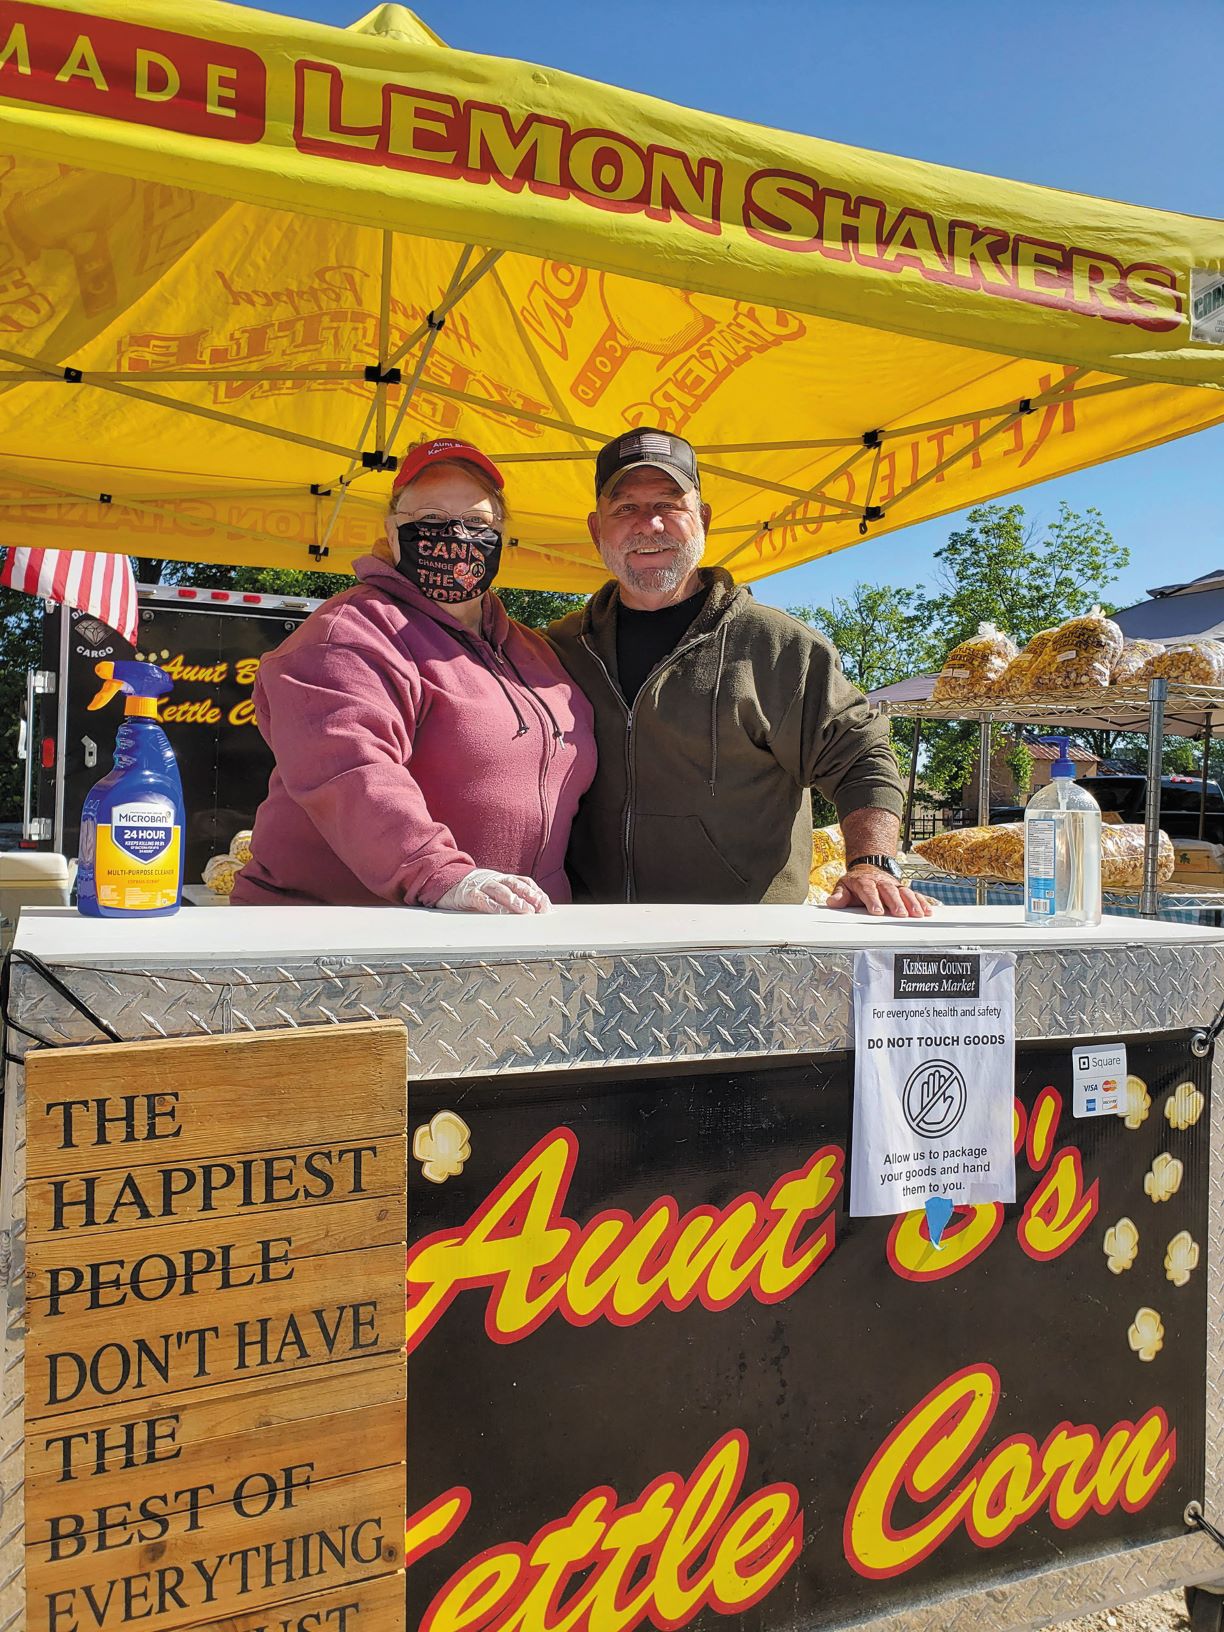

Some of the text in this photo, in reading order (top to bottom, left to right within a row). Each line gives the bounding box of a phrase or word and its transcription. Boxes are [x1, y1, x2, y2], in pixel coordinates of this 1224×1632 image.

[294, 59, 722, 236] LEMON
[744, 168, 1187, 332] SHAKERS
[417, 540, 468, 560] CAN
[418, 558, 454, 571] CHANGE
[416, 568, 454, 587] THE
[76, 645, 114, 659] CARGO
[160, 654, 228, 683] Aunt
[123, 829, 166, 840] 24 HOUR
[899, 978, 976, 992] Farmers Market
[872, 1006, 1002, 1021] For everyone's health and safety
[867, 1034, 1005, 1050] DO NOT TOUCH GOODS
[1092, 1057, 1121, 1068] Square
[1084, 1084, 1098, 1092] VISA
[46, 1091, 182, 1150] THE
[883, 1146, 988, 1166] Allow us to package
[880, 1161, 991, 1186] your goods and hand
[47, 1146, 377, 1231] HAPPIEST
[902, 1180, 966, 1197] them to you.
[405, 1126, 845, 1356] Aunt
[44, 1237, 294, 1317] PEOPLE
[44, 1301, 380, 1405] DON'T HAVE
[46, 1415, 182, 1483] THE
[844, 1363, 1176, 1580] Corn
[44, 1463, 315, 1563] BEST OF
[46, 1517, 386, 1632] EVERYTHING
